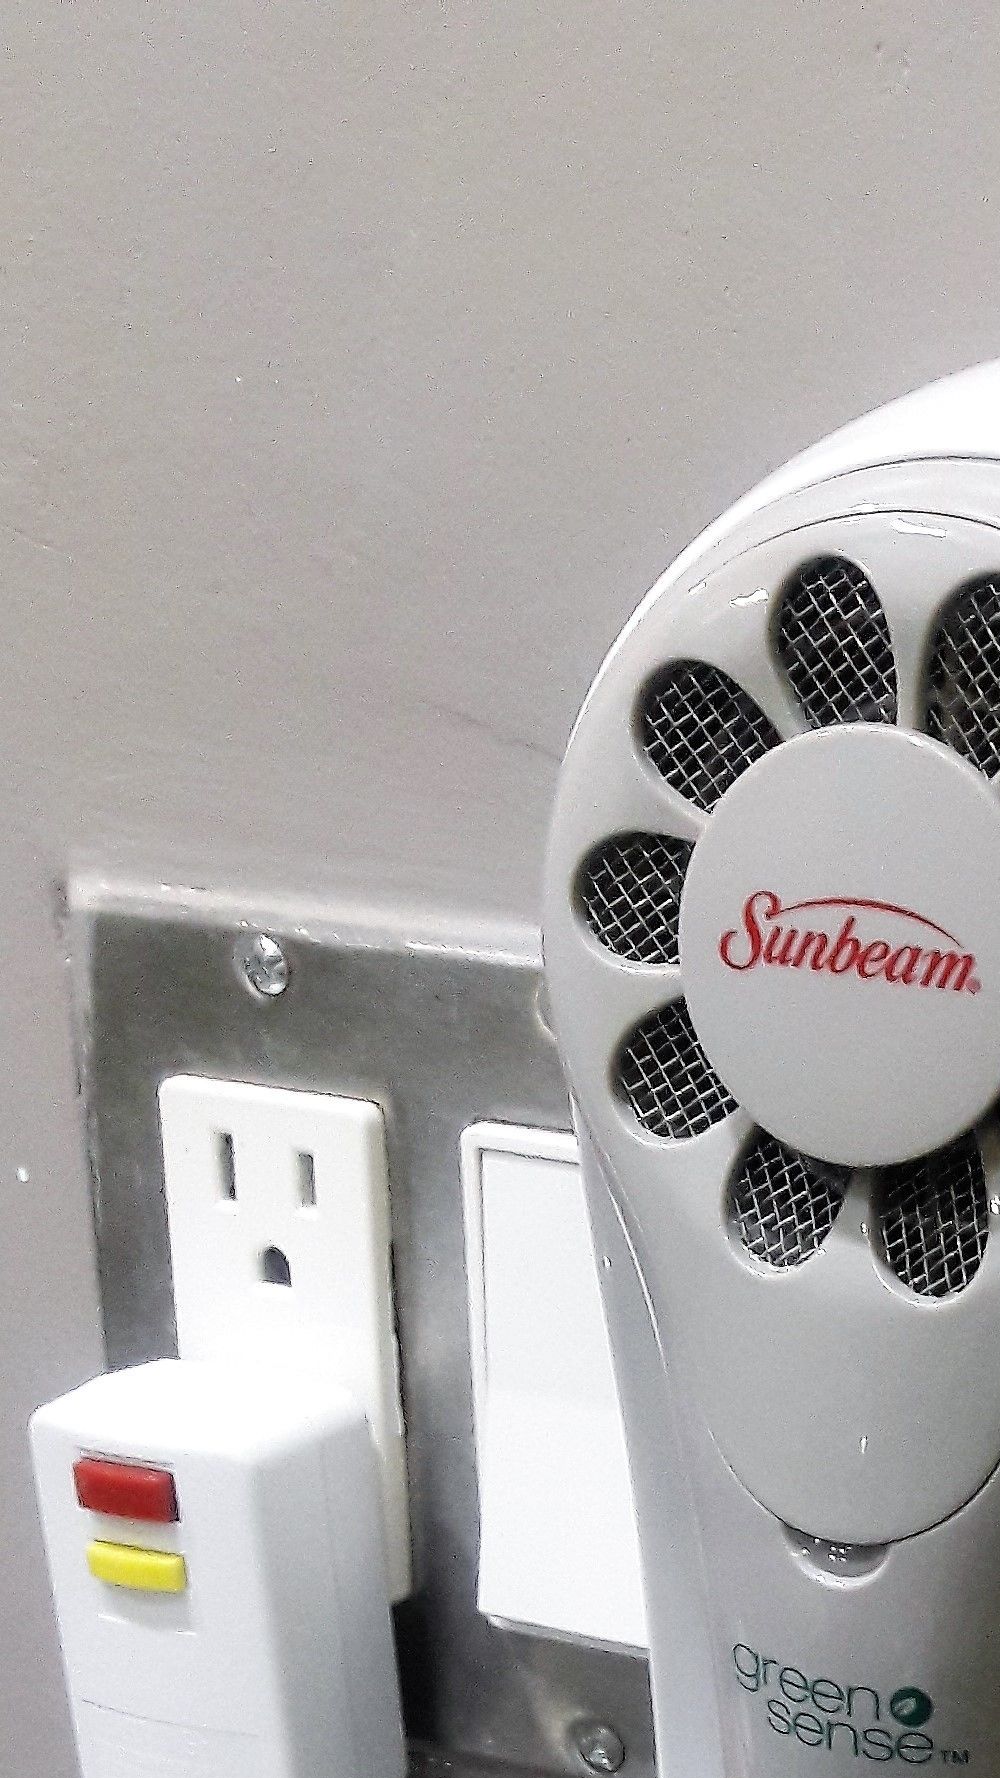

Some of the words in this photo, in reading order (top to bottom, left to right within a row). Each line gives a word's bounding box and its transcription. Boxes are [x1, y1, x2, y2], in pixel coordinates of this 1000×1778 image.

[719, 890, 976, 991] Sunbeam
[733, 1643, 880, 1720] green
[767, 1699, 934, 1763] sense
